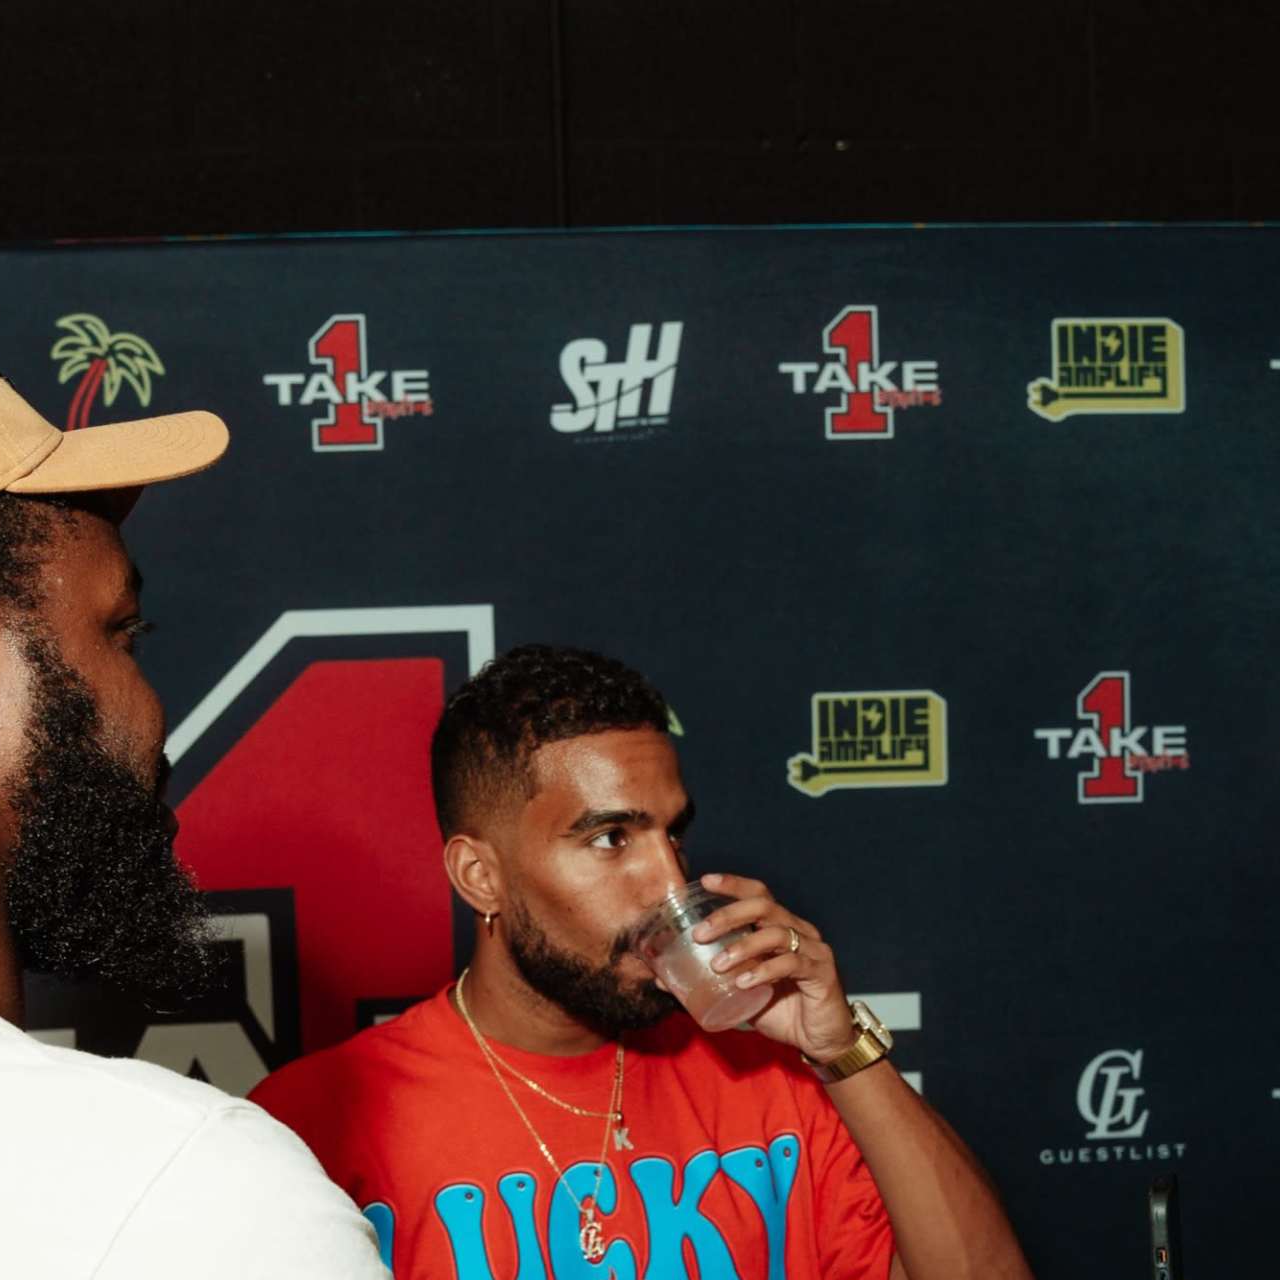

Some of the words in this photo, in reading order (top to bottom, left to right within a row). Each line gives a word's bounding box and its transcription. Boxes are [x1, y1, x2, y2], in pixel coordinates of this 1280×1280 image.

[1057, 325, 1167, 364] INDIE
[262, 369, 430, 406] TAKE
[777, 360, 939, 395] TAKE
[819, 700, 928, 737] INDIE
[1033, 725, 1187, 759] TAKE
[1039, 1143, 1186, 1165] GUESTLIST
